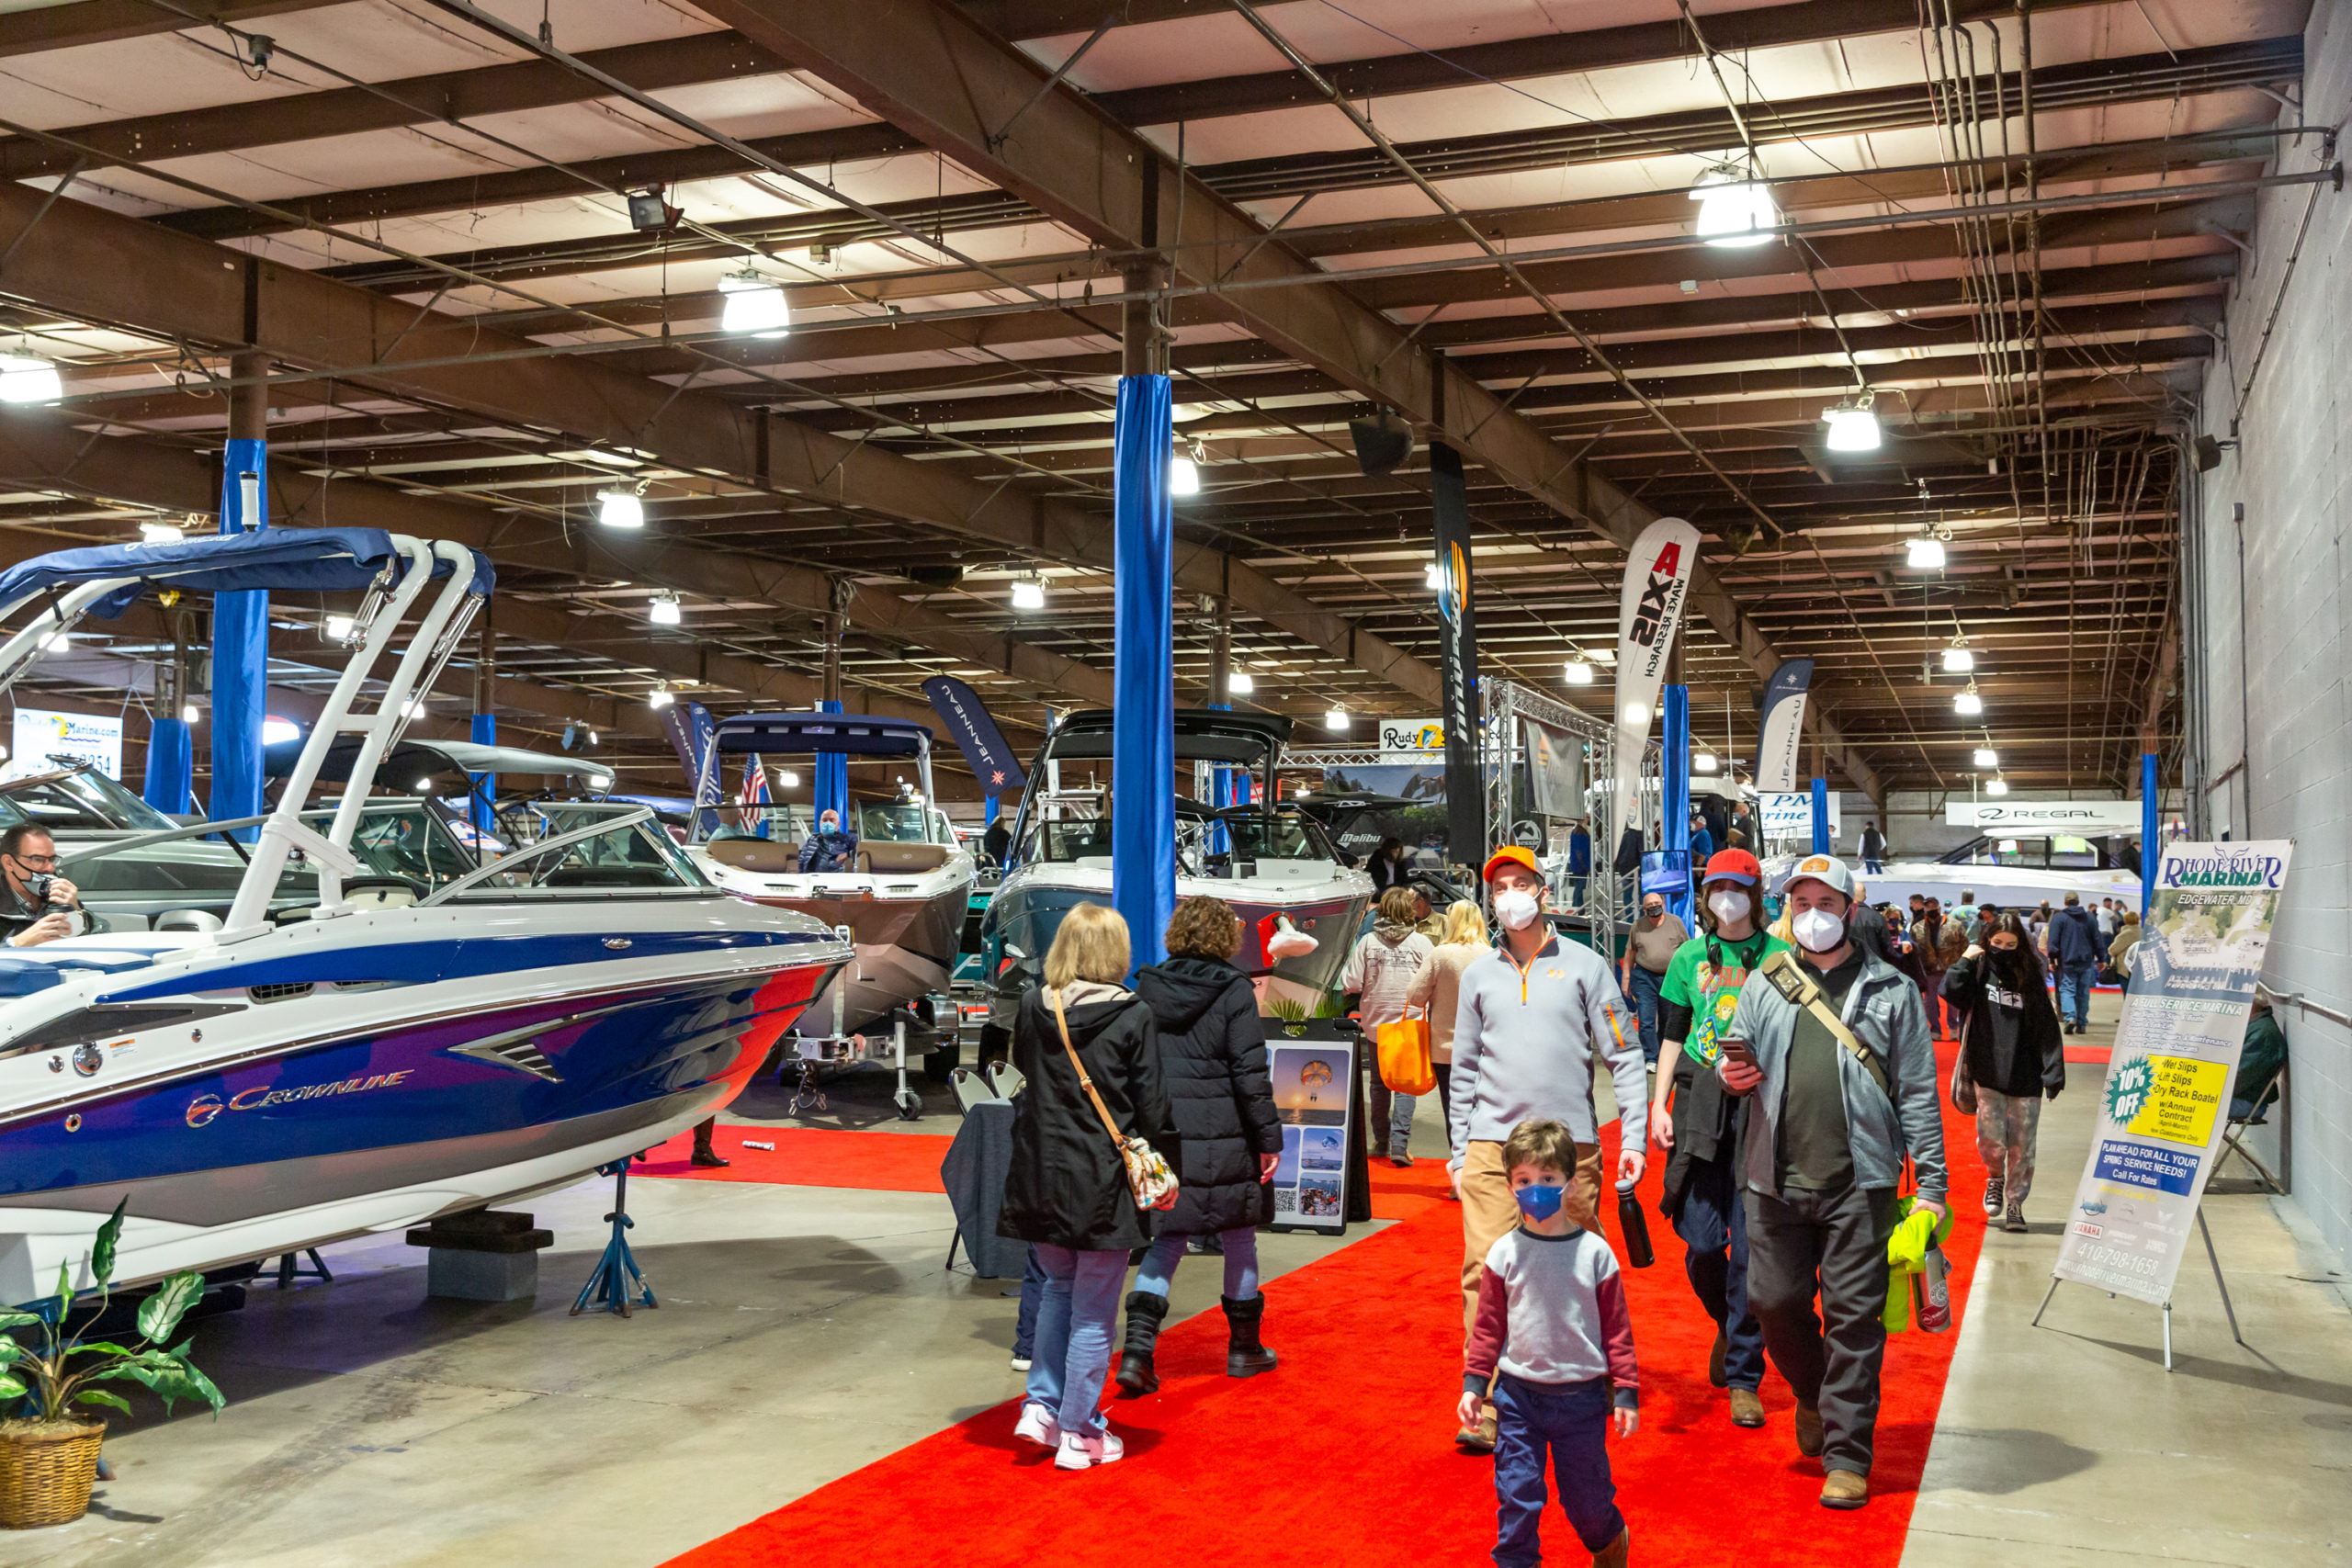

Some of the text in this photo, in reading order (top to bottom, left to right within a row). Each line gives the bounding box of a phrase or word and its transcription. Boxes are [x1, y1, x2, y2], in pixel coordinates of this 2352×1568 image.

[942, 684, 994, 765] JEANNEAU
[1383, 728, 1419, 750] Rudy
[1780, 699, 1801, 787] JEANNEAU
[2013, 810, 2105, 818] REGAL
[1340, 831, 1382, 843] Malibu
[2162, 855, 2282, 888] RHODE RIVER
[2179, 872, 2263, 886] MARINA
[1701, 966, 1747, 992] ZELD
[2160, 998, 2201, 1012] SERVICE
[2203, 1002, 2243, 1016] MARINA
[2119, 1065, 2145, 1091] 10%
[2178, 1061, 2198, 1073] Slips
[229, 1069, 415, 1111] CROWNLINE
[2172, 1074, 2192, 1086] Slips
[2169, 1087, 2188, 1099] Rack
[2115, 1092, 2140, 1118] OFF
[2159, 1110, 2192, 1122] Contract
[2101, 1143, 2198, 1168] PLAN AHEAD FOR ALL YOUR
[2103, 1155, 2188, 1179] SPRING SERVICE NEEDS!
[2112, 1168, 2157, 1186] Call For Rates
[2076, 1242, 2159, 1276] 410-798-1658
